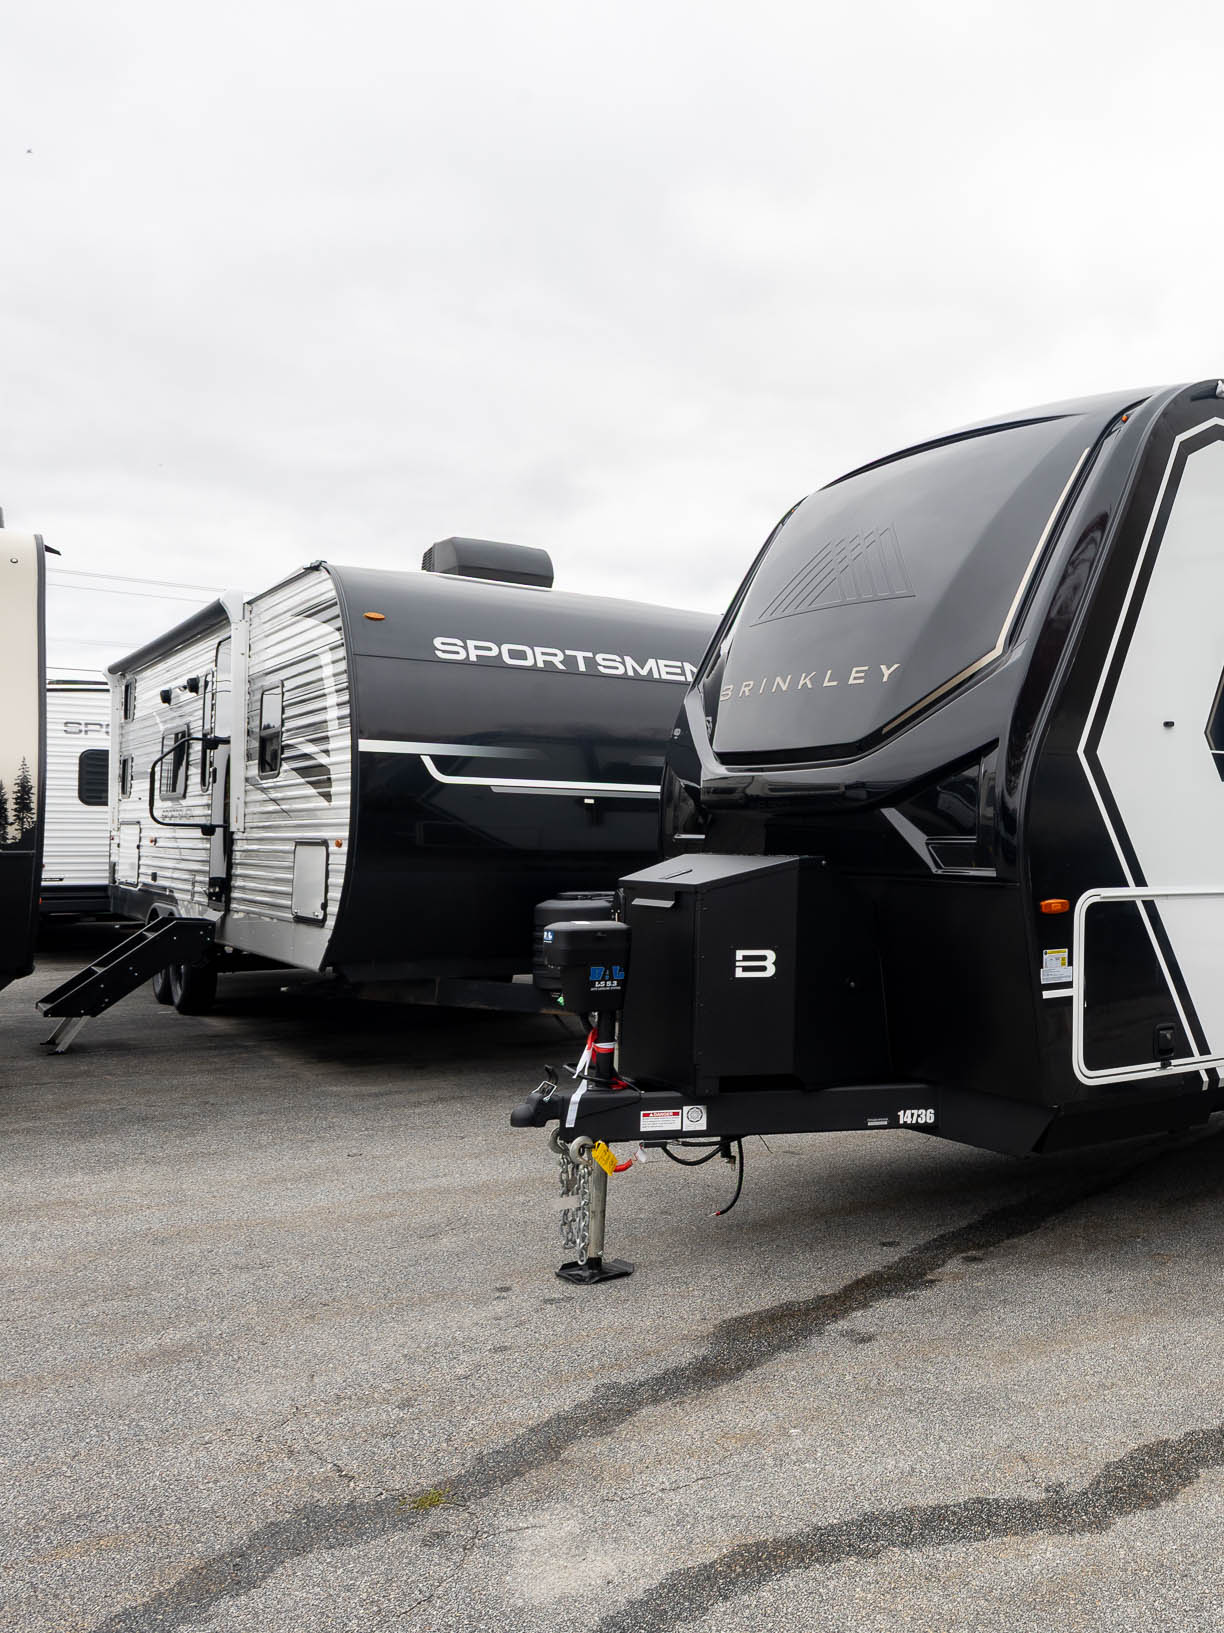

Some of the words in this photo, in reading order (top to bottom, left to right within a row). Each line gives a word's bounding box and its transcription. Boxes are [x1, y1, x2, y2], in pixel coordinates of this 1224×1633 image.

[719, 663, 901, 702] BRINKLEY
[63, 721, 110, 737] SP
[735, 949, 777, 978] B
[897, 1108, 935, 1124] 14736
